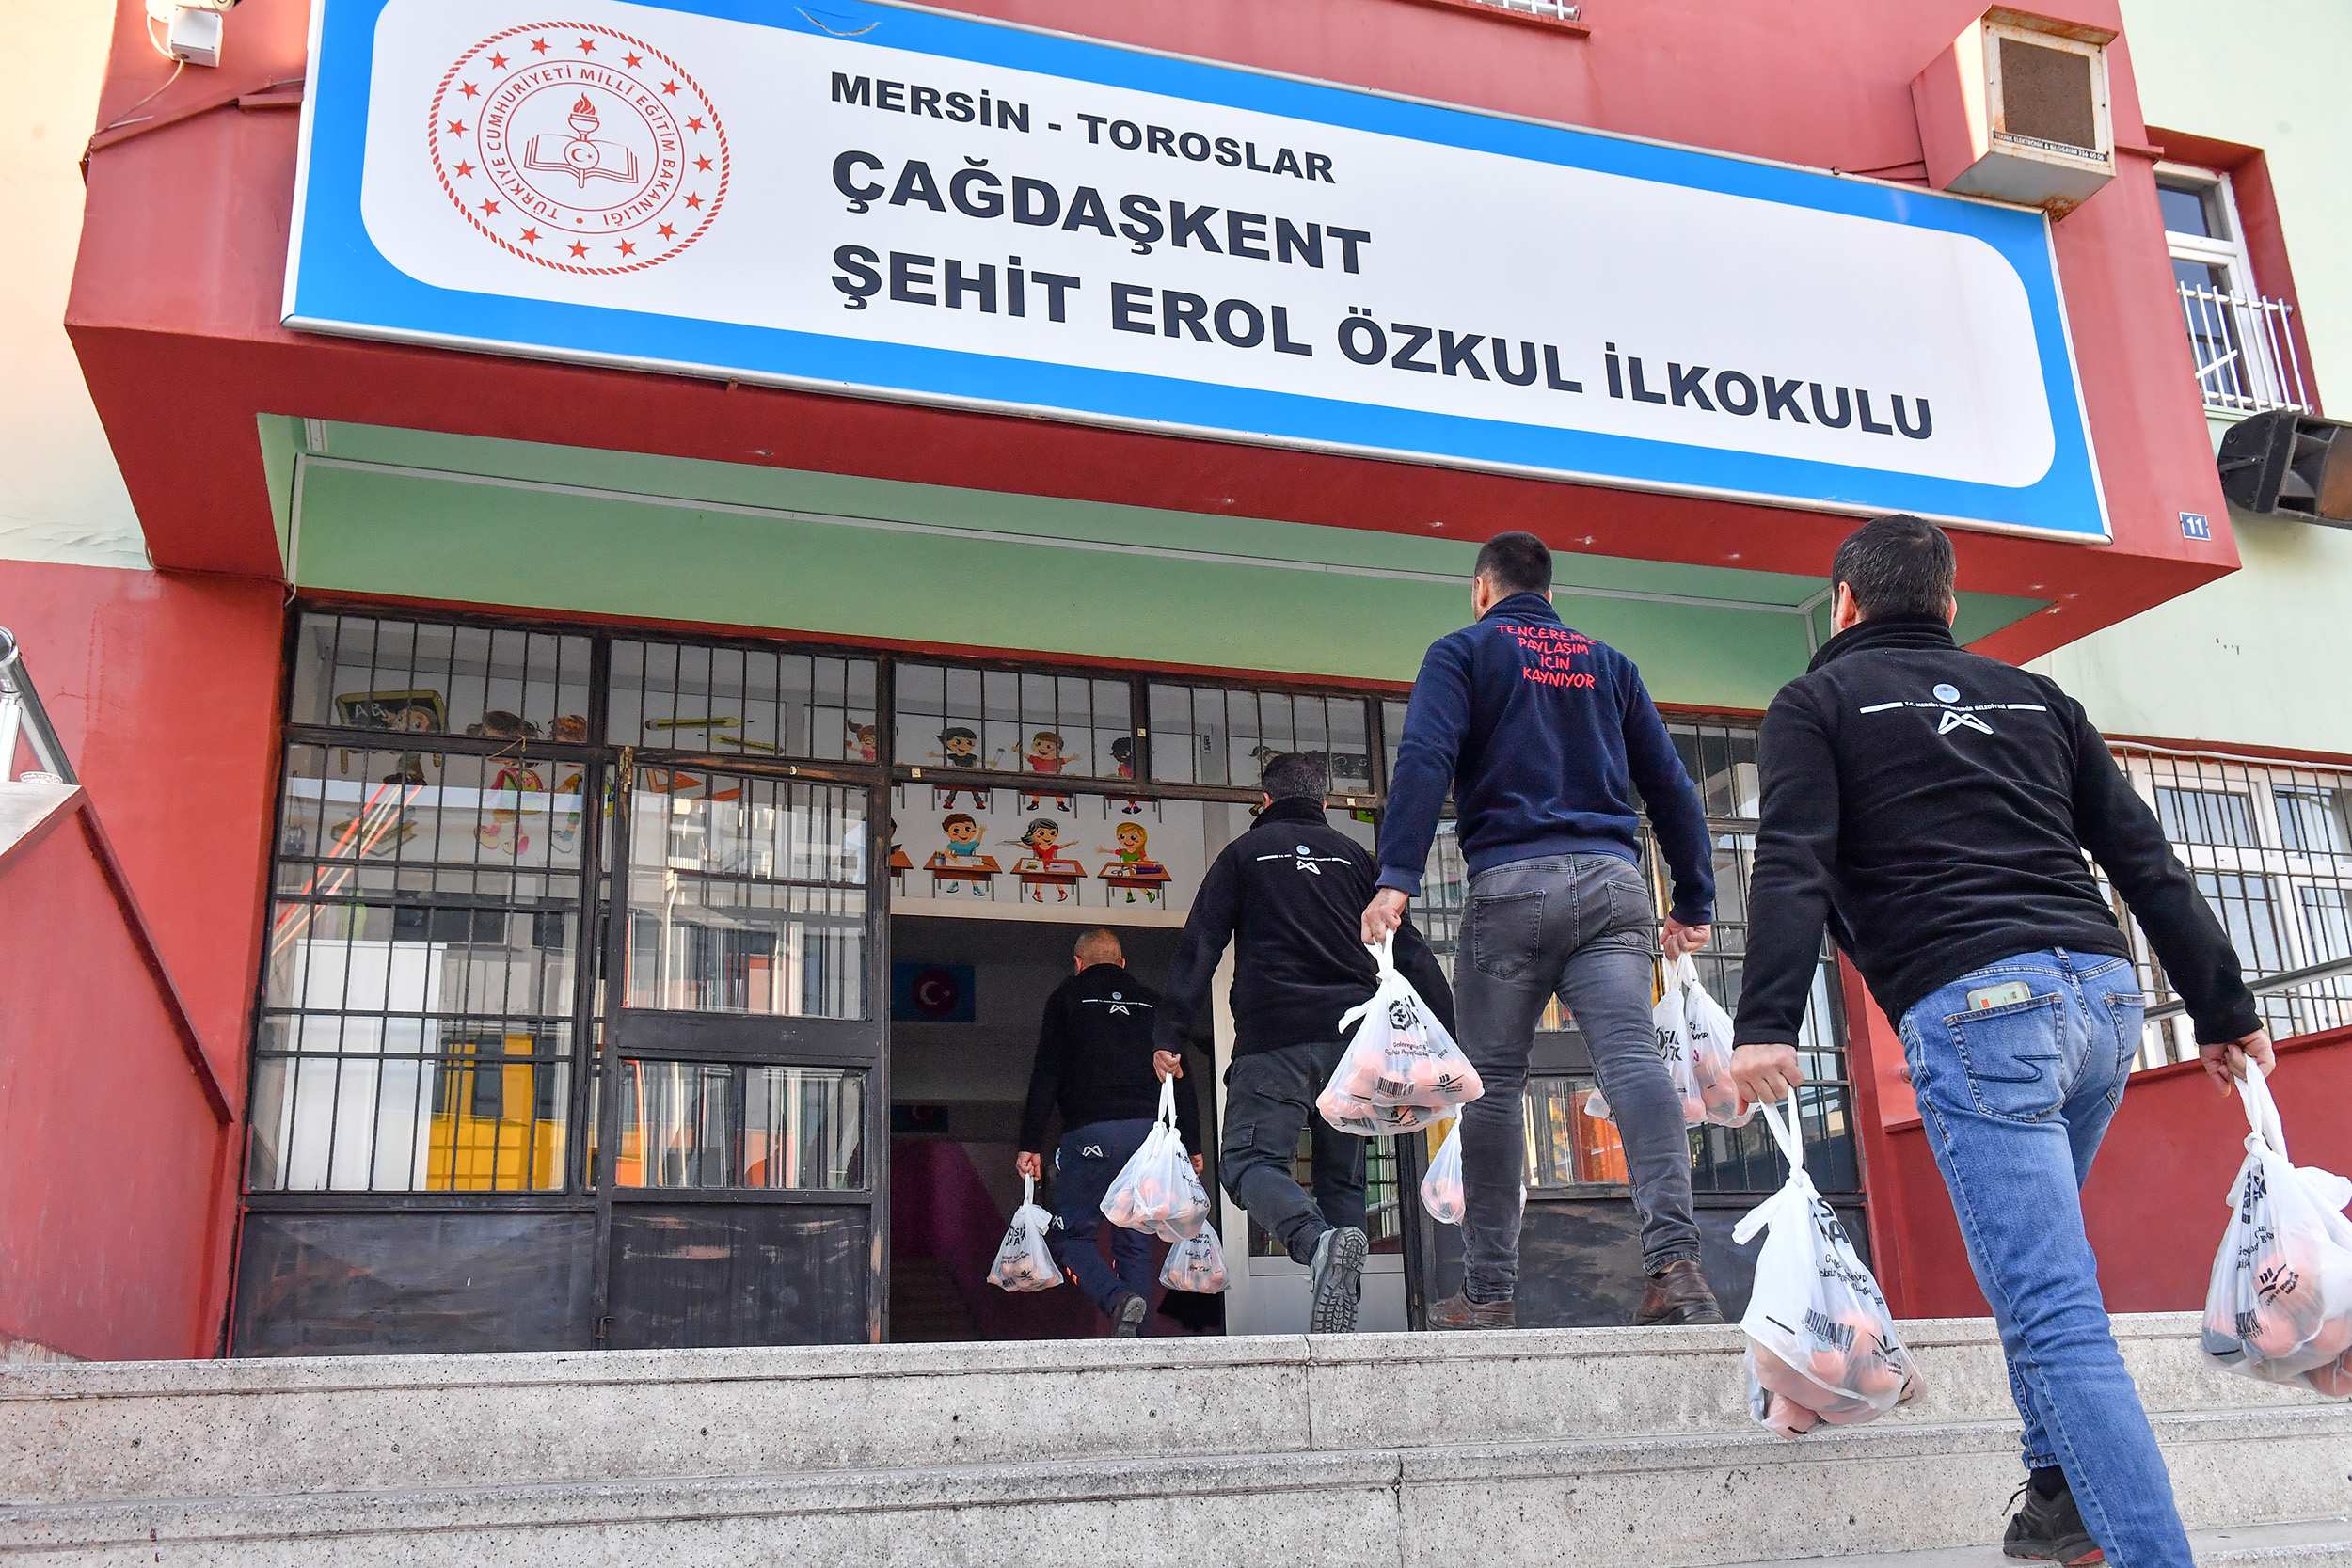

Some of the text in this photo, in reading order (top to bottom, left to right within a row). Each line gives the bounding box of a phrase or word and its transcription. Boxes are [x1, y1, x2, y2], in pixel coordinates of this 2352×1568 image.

[485, 64, 572, 151] CUMHURİYETİ
[635, 93, 676, 153] EĞİTİM
[831, 71, 1030, 134] MERSİN
[1077, 112, 1336, 184] TOROSLAR
[495, 158, 559, 222] TÜRKİYE
[602, 158, 676, 228] BAKANLIĞI
[831, 150, 1372, 276] ÇAĞDAŞKENT
[831, 245, 1933, 440] ŞEHİT EROL ÖZKUL İLKOKULU
[2186, 516, 2204, 536] 11
[1518, 637, 1590, 656] PAYLAŞIM
[1522, 666, 1597, 689] KAYNIYOR
[1539, 653, 1571, 671] İÇİN
